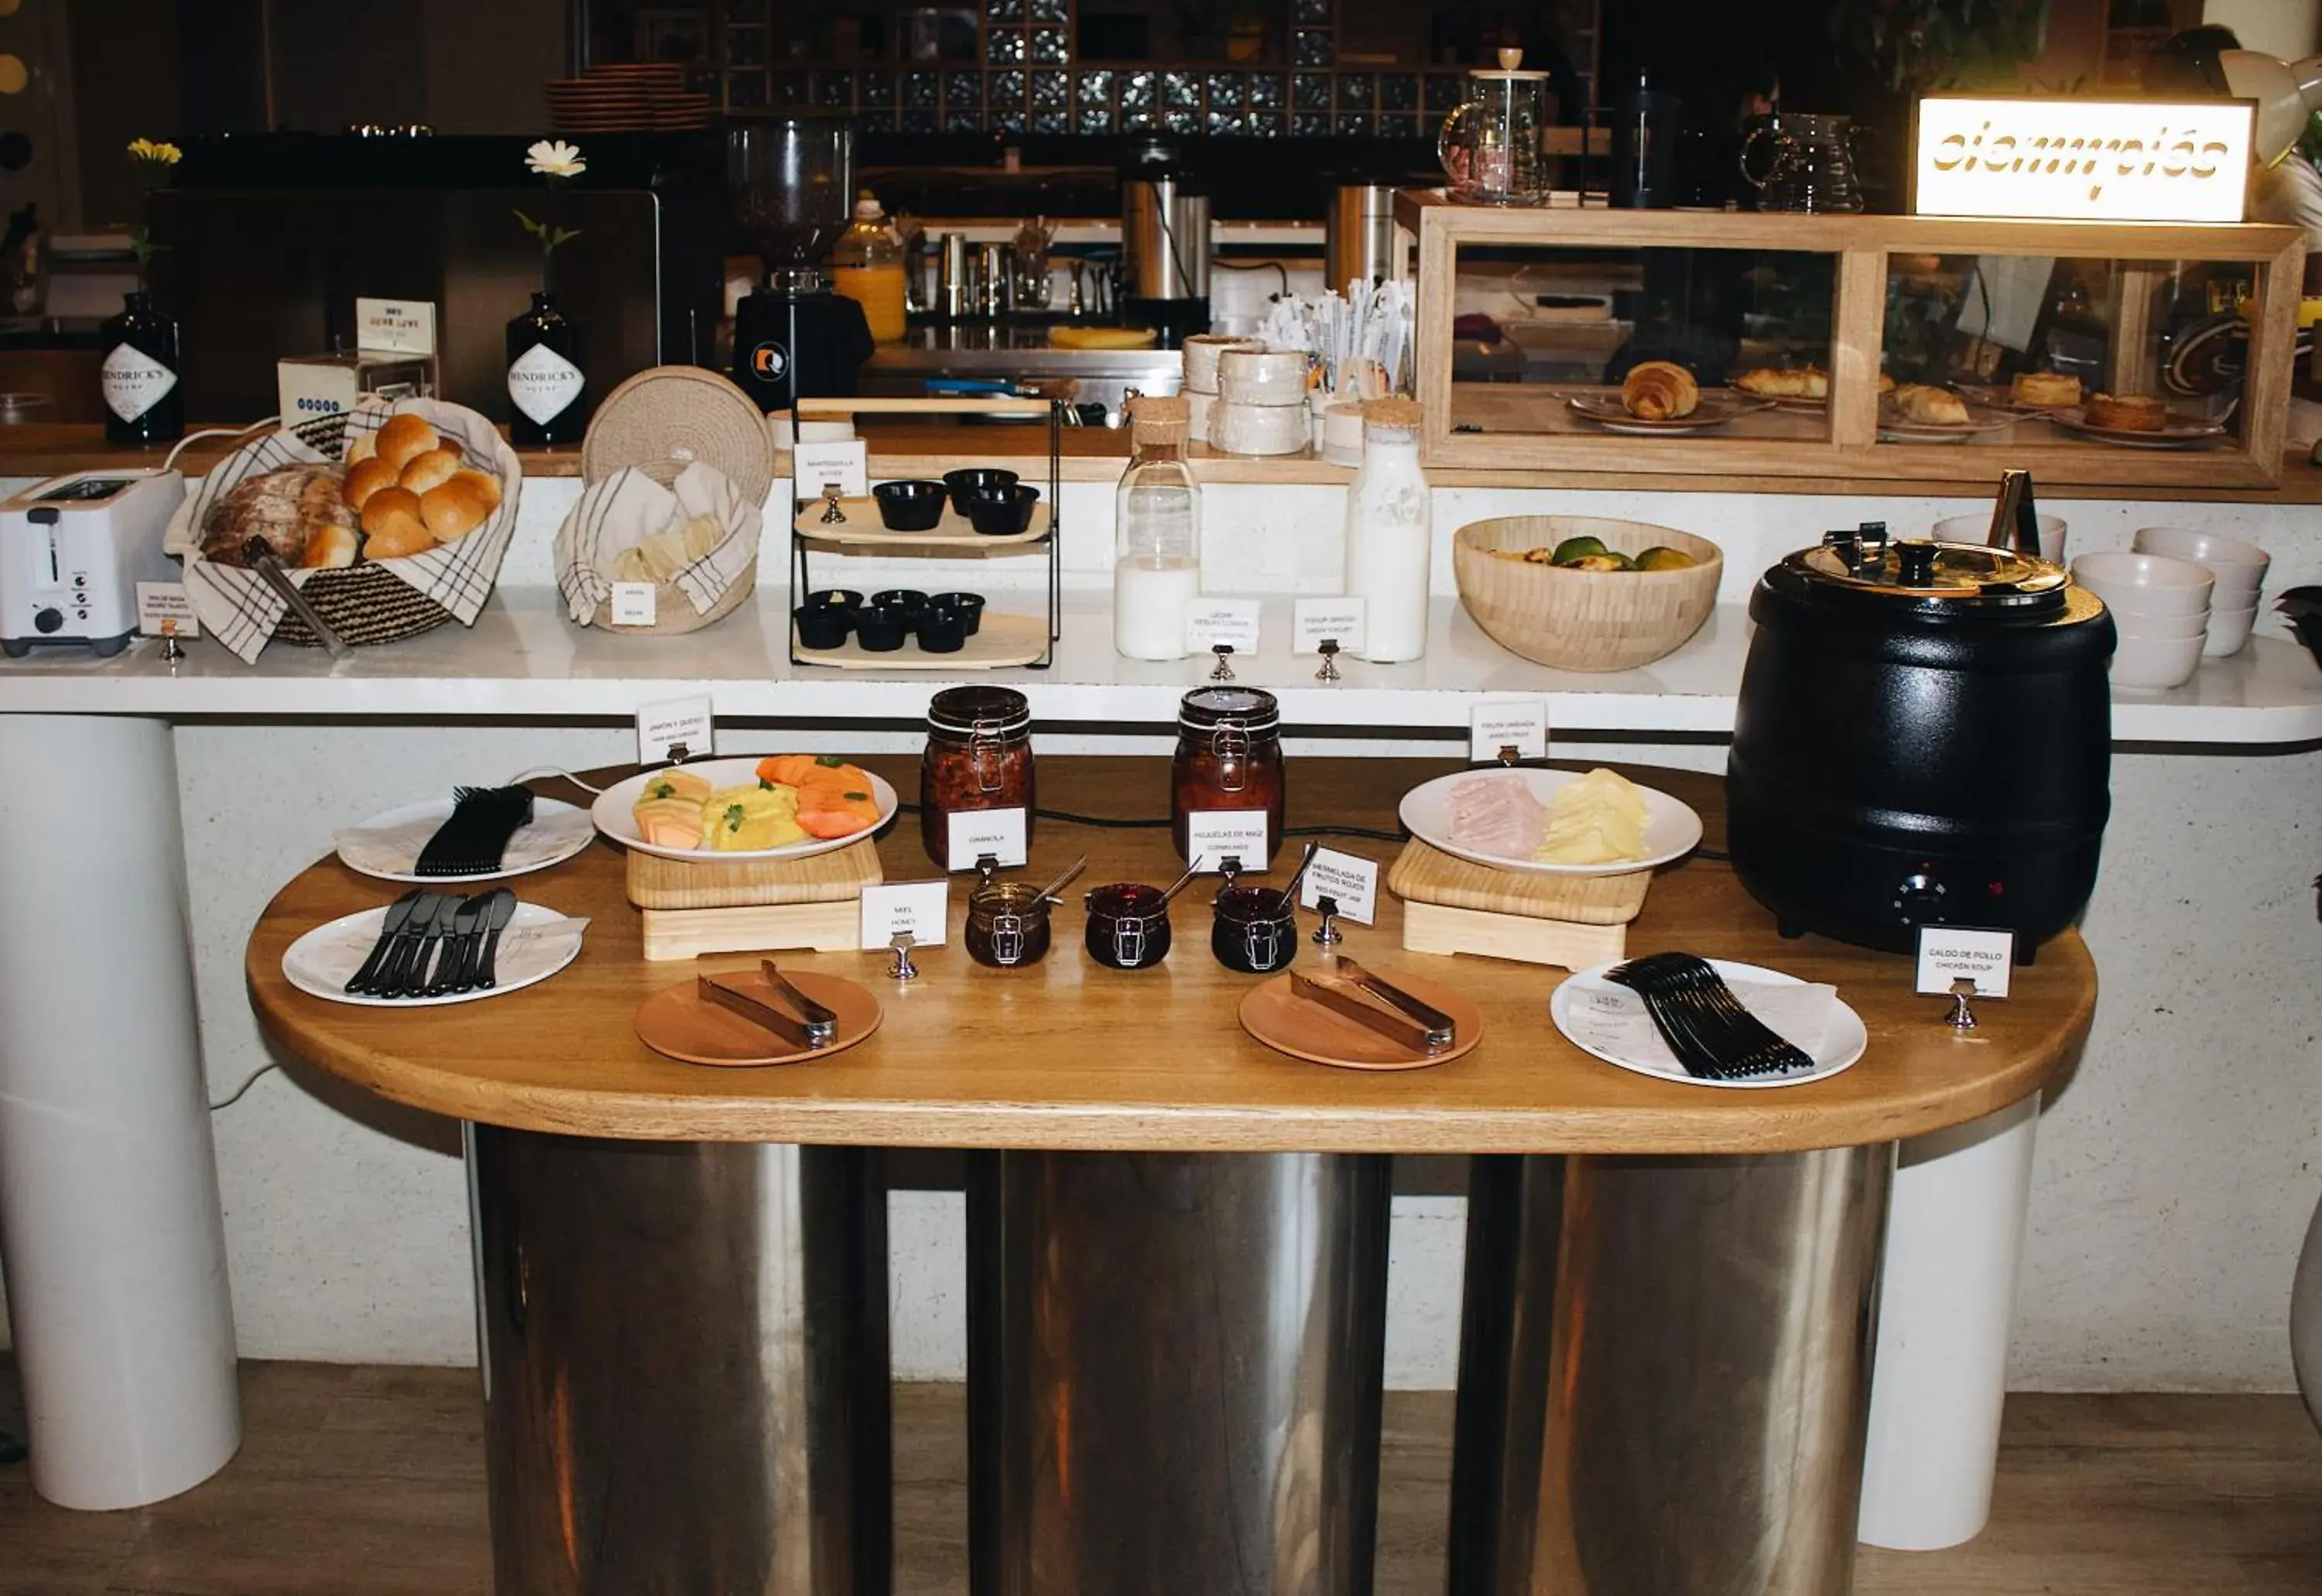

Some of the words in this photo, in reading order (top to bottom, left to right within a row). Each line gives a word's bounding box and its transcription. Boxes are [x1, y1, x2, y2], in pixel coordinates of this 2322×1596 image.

[968, 835, 1005, 844] GRANOLA
[1312, 862, 1355, 879] MERMELADA
[1356, 872, 1366, 883] DE
[1312, 872, 1340, 885] FRUTOS
[1341, 878, 1365, 892] ROJOS
[1316, 885, 1329, 894] RED
[1329, 888, 1348, 899] FRUIT
[1929, 949, 1958, 958] CALDO
[1973, 951, 2003, 961] POLLO
[1936, 961, 1970, 971] CHICKEN
[1971, 963, 1994, 971] SOUP
